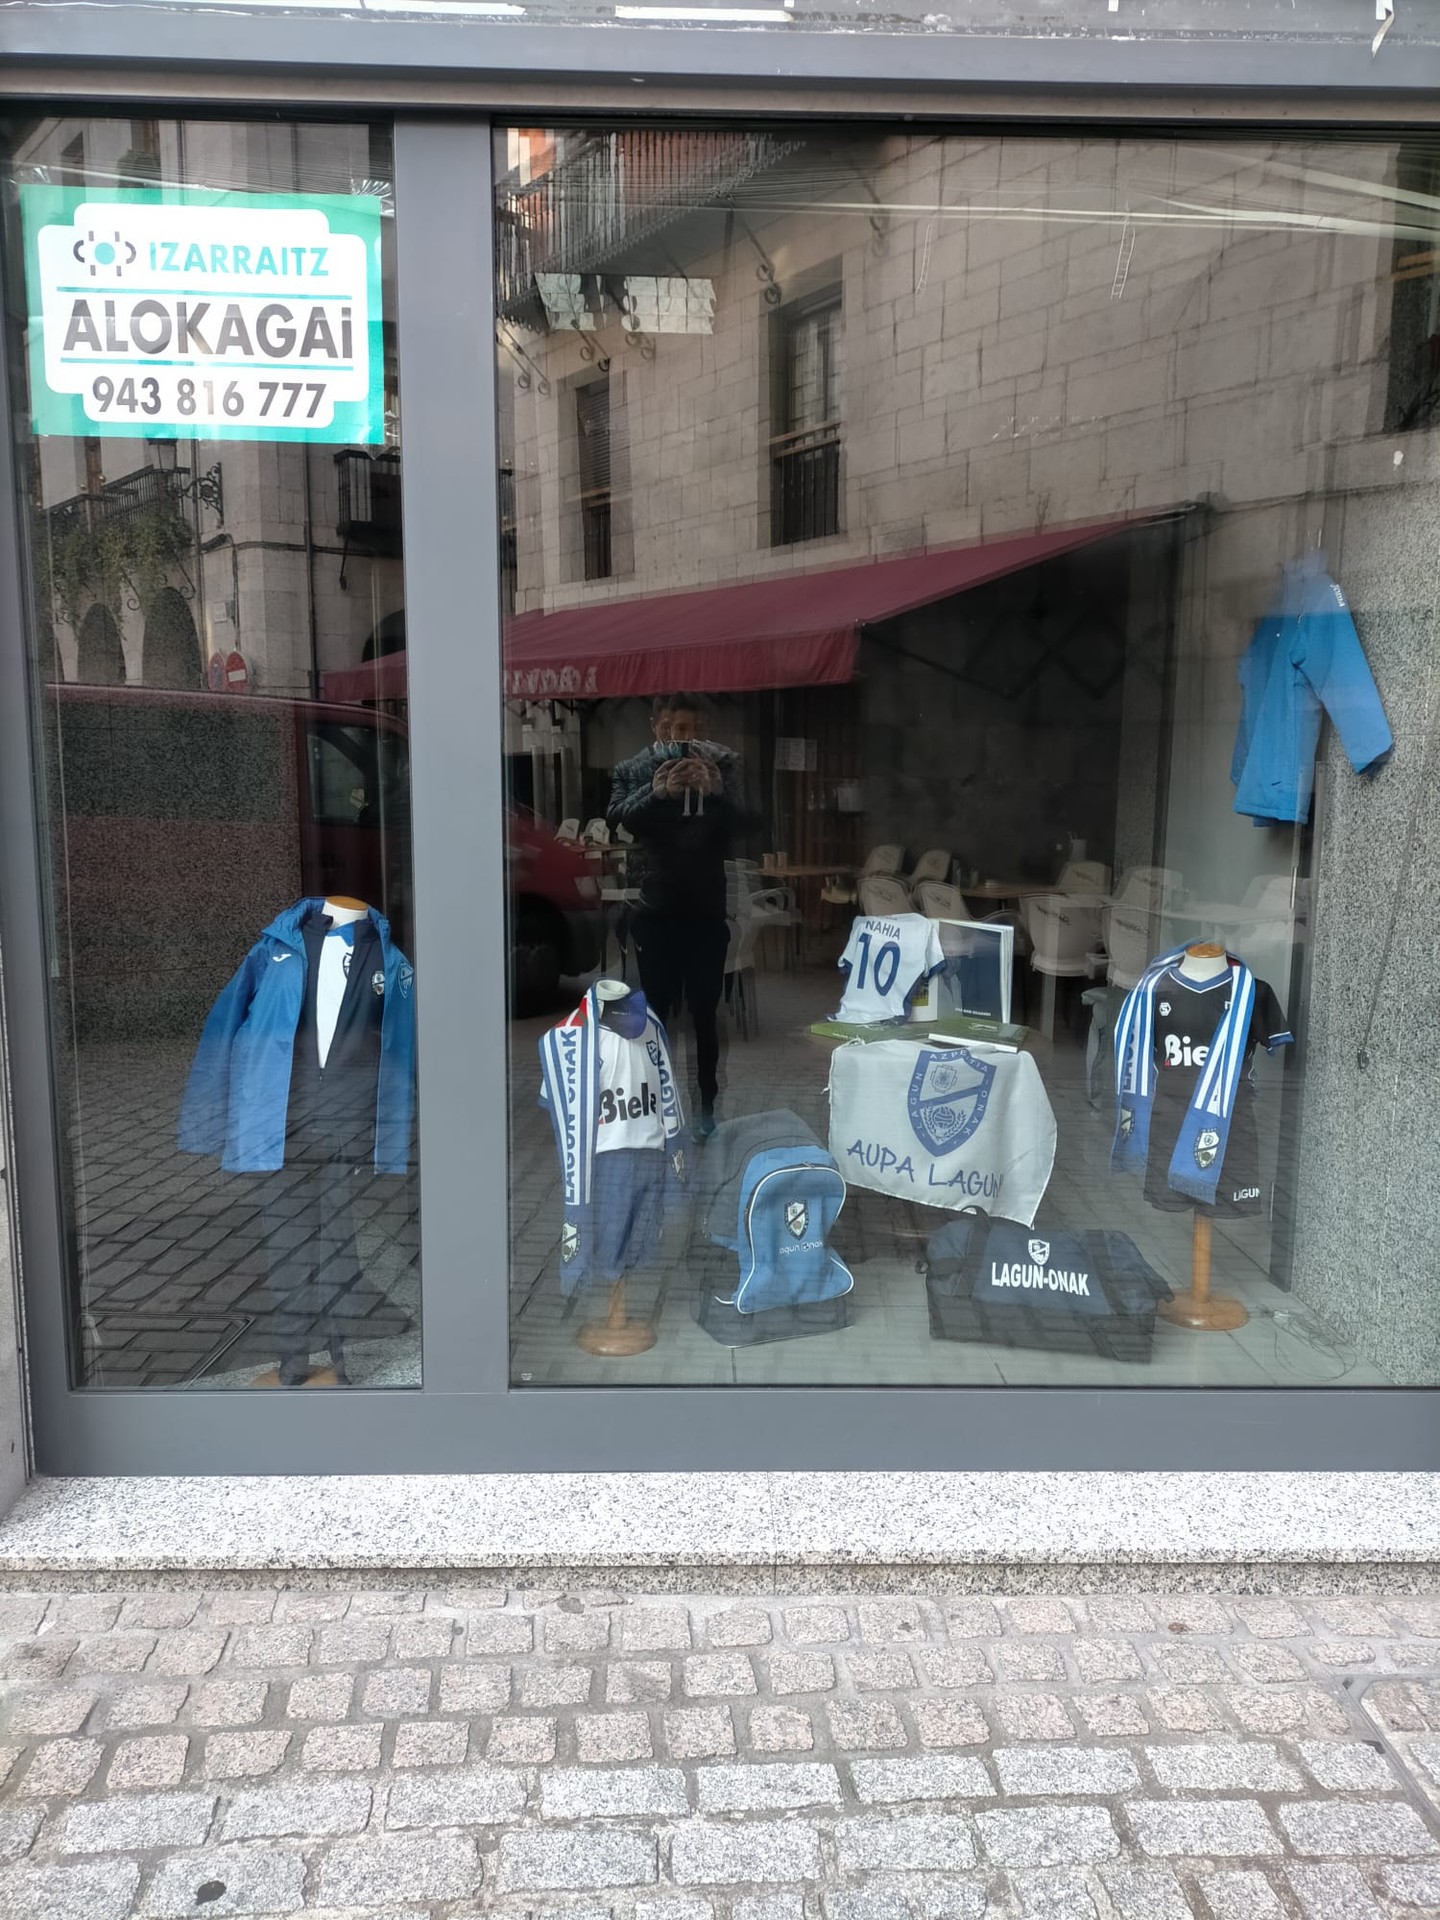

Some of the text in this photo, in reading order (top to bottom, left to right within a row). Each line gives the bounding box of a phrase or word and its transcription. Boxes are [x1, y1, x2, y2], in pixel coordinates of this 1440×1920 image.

[150, 241, 329, 277] IZARRAITZ
[93, 375, 327, 418] 943 816 777
[865, 920, 901, 940] NAHIA
[857, 932, 901, 997] 10
[929, 1048, 989, 1073] AZPEITIA
[910, 1072, 923, 1130] LAGUN
[963, 1090, 988, 1136] ONAK
[846, 1138, 1004, 1199] AUPA LAGUN
[991, 1261, 1091, 1297] LAGUN-ONAK
